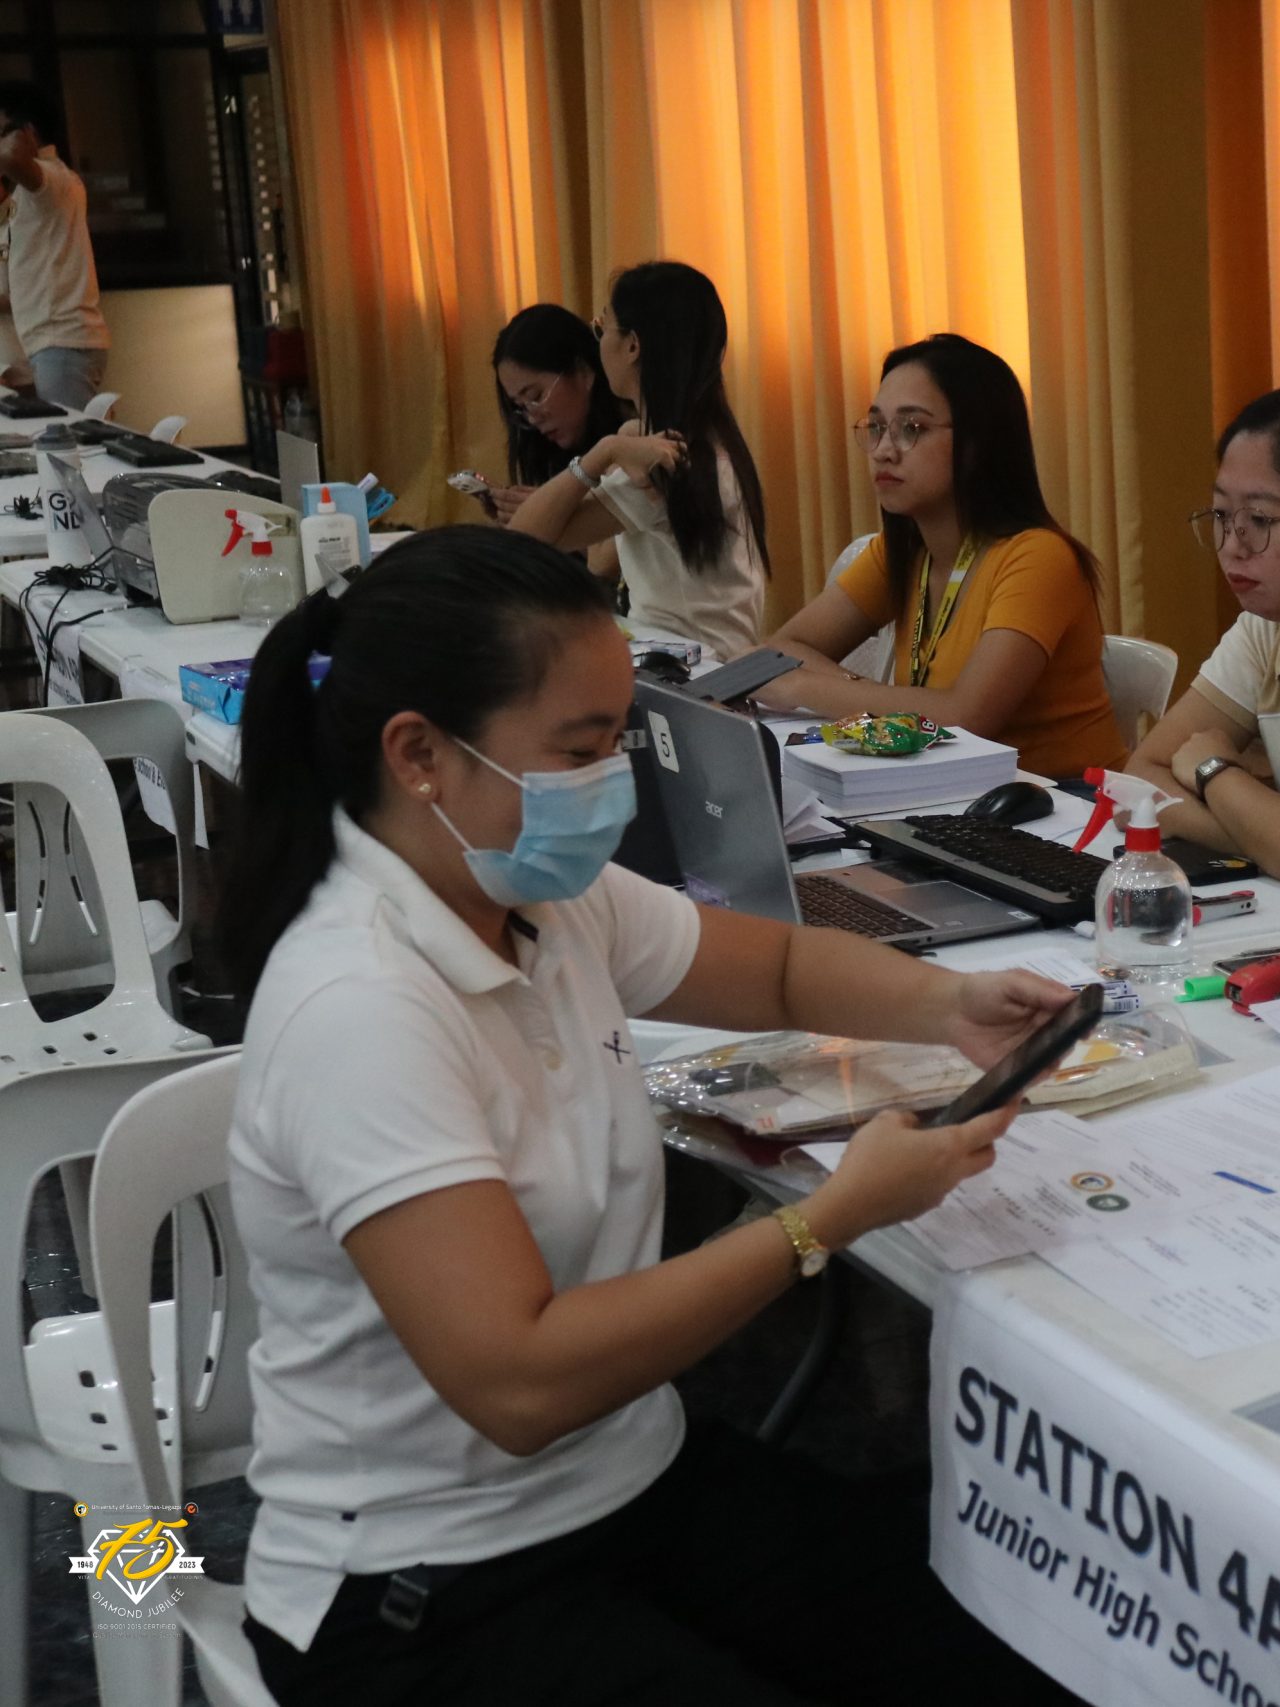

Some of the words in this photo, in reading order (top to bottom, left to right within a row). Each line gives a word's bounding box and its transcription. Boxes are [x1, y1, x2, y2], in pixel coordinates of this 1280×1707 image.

[660, 732, 670, 758] 5
[704, 800, 724, 819] acer
[955, 1366, 1200, 1595] STATION
[958, 1480, 1069, 1582] Junior
[1073, 1555, 1161, 1648] High
